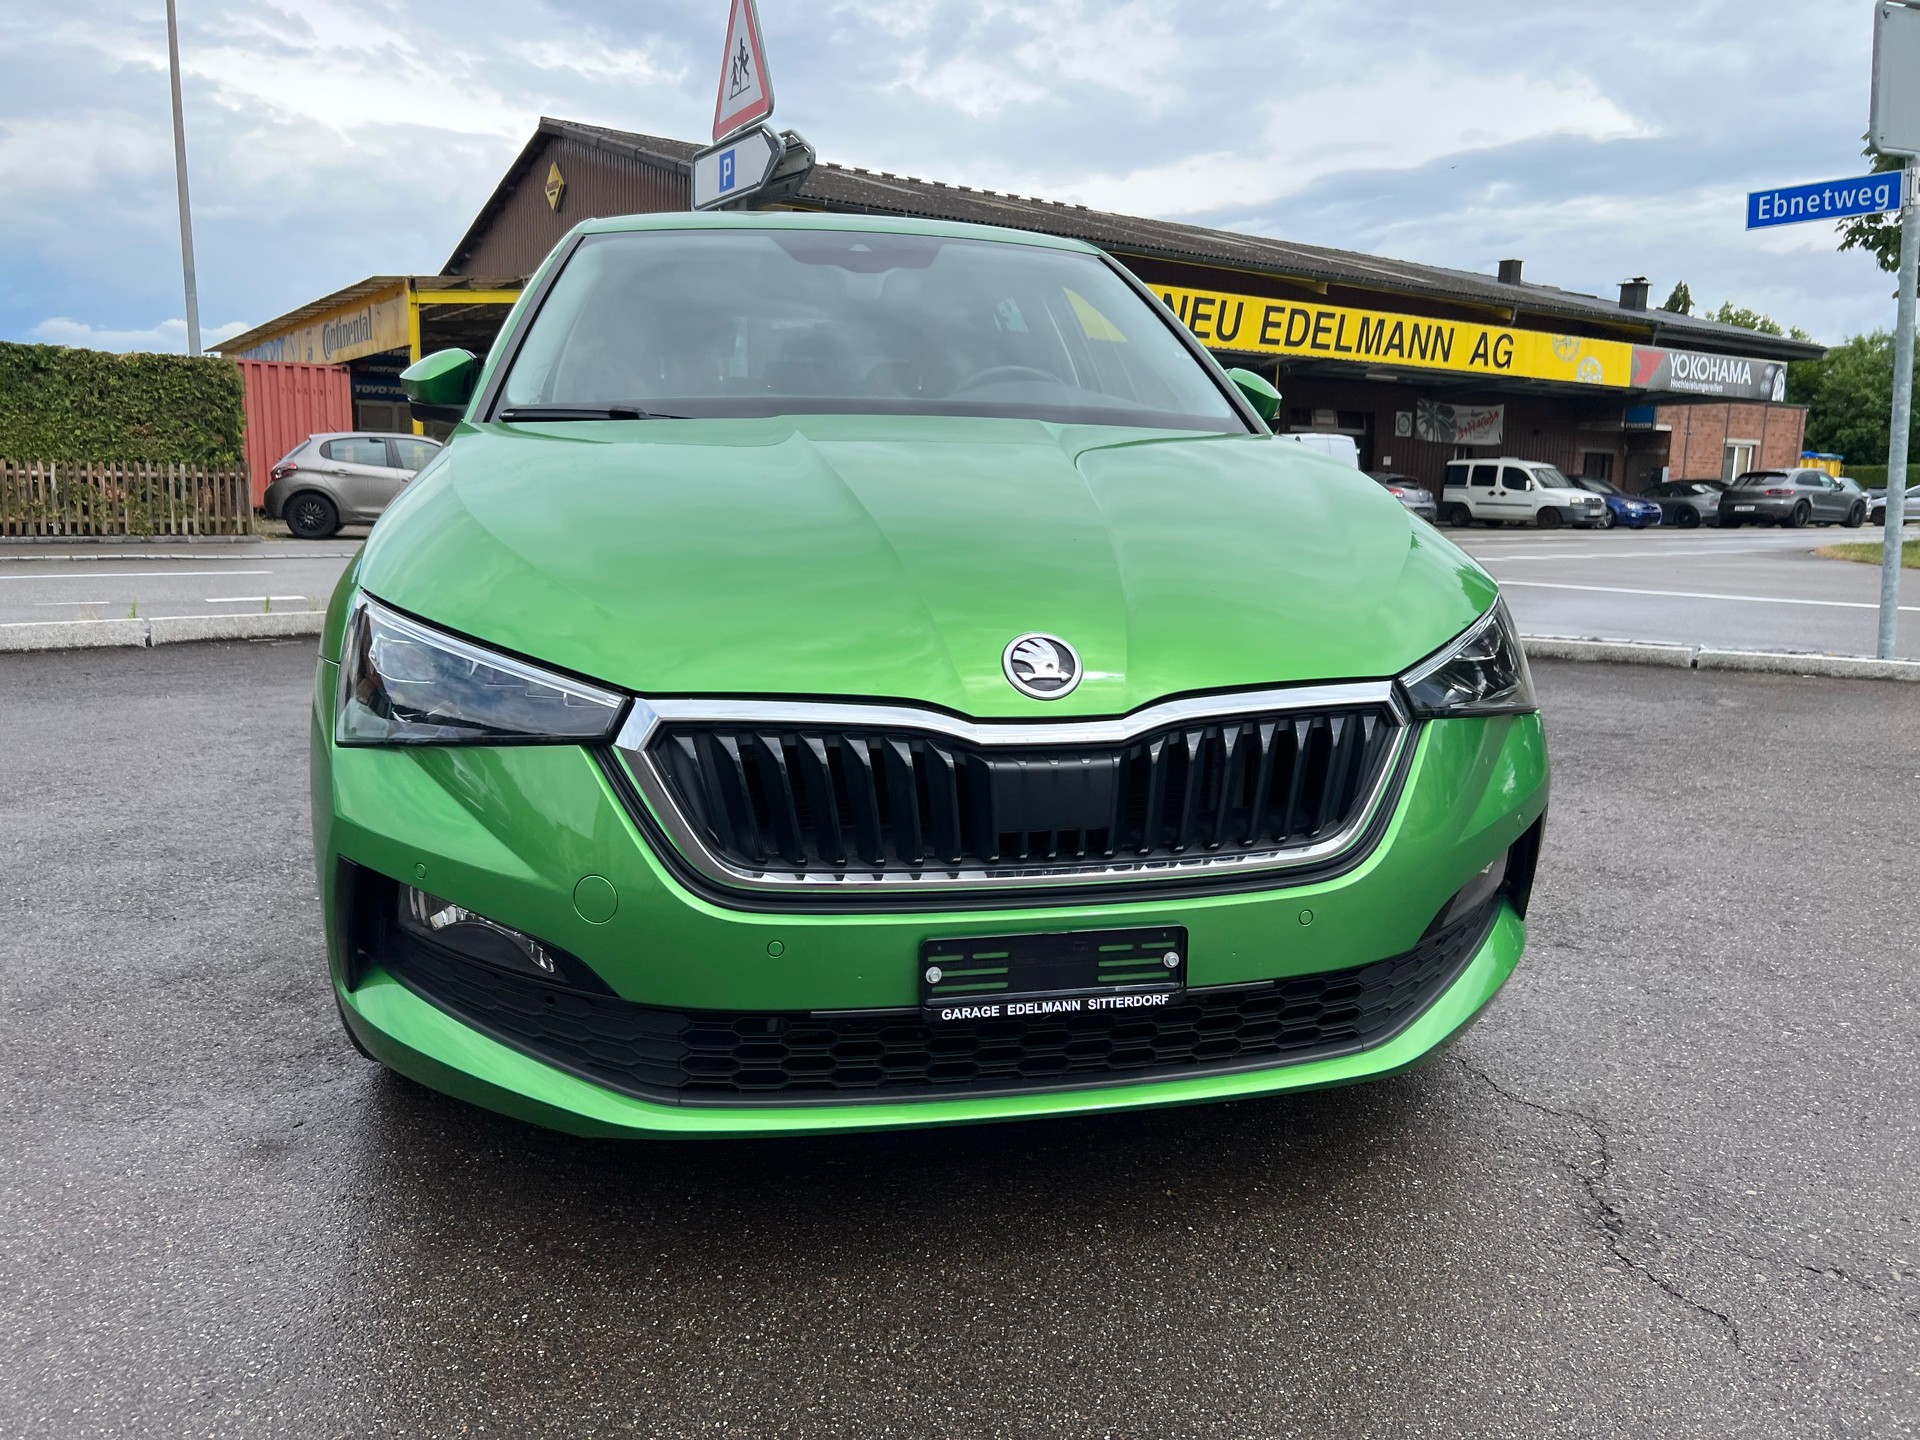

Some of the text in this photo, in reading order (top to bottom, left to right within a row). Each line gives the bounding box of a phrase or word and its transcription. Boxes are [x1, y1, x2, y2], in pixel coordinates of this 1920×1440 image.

[723, 158, 731, 187] P
[1757, 184, 1890, 220] Ebnetweg
[322, 306, 373, 360] Continental
[1258, 305, 1456, 363] EDELMANN
[1468, 332, 1515, 369] AG
[1669, 353, 1752, 385] YOKOHAMA
[941, 994, 1170, 1020] GARAGE EDELMANN SITTERDORF
